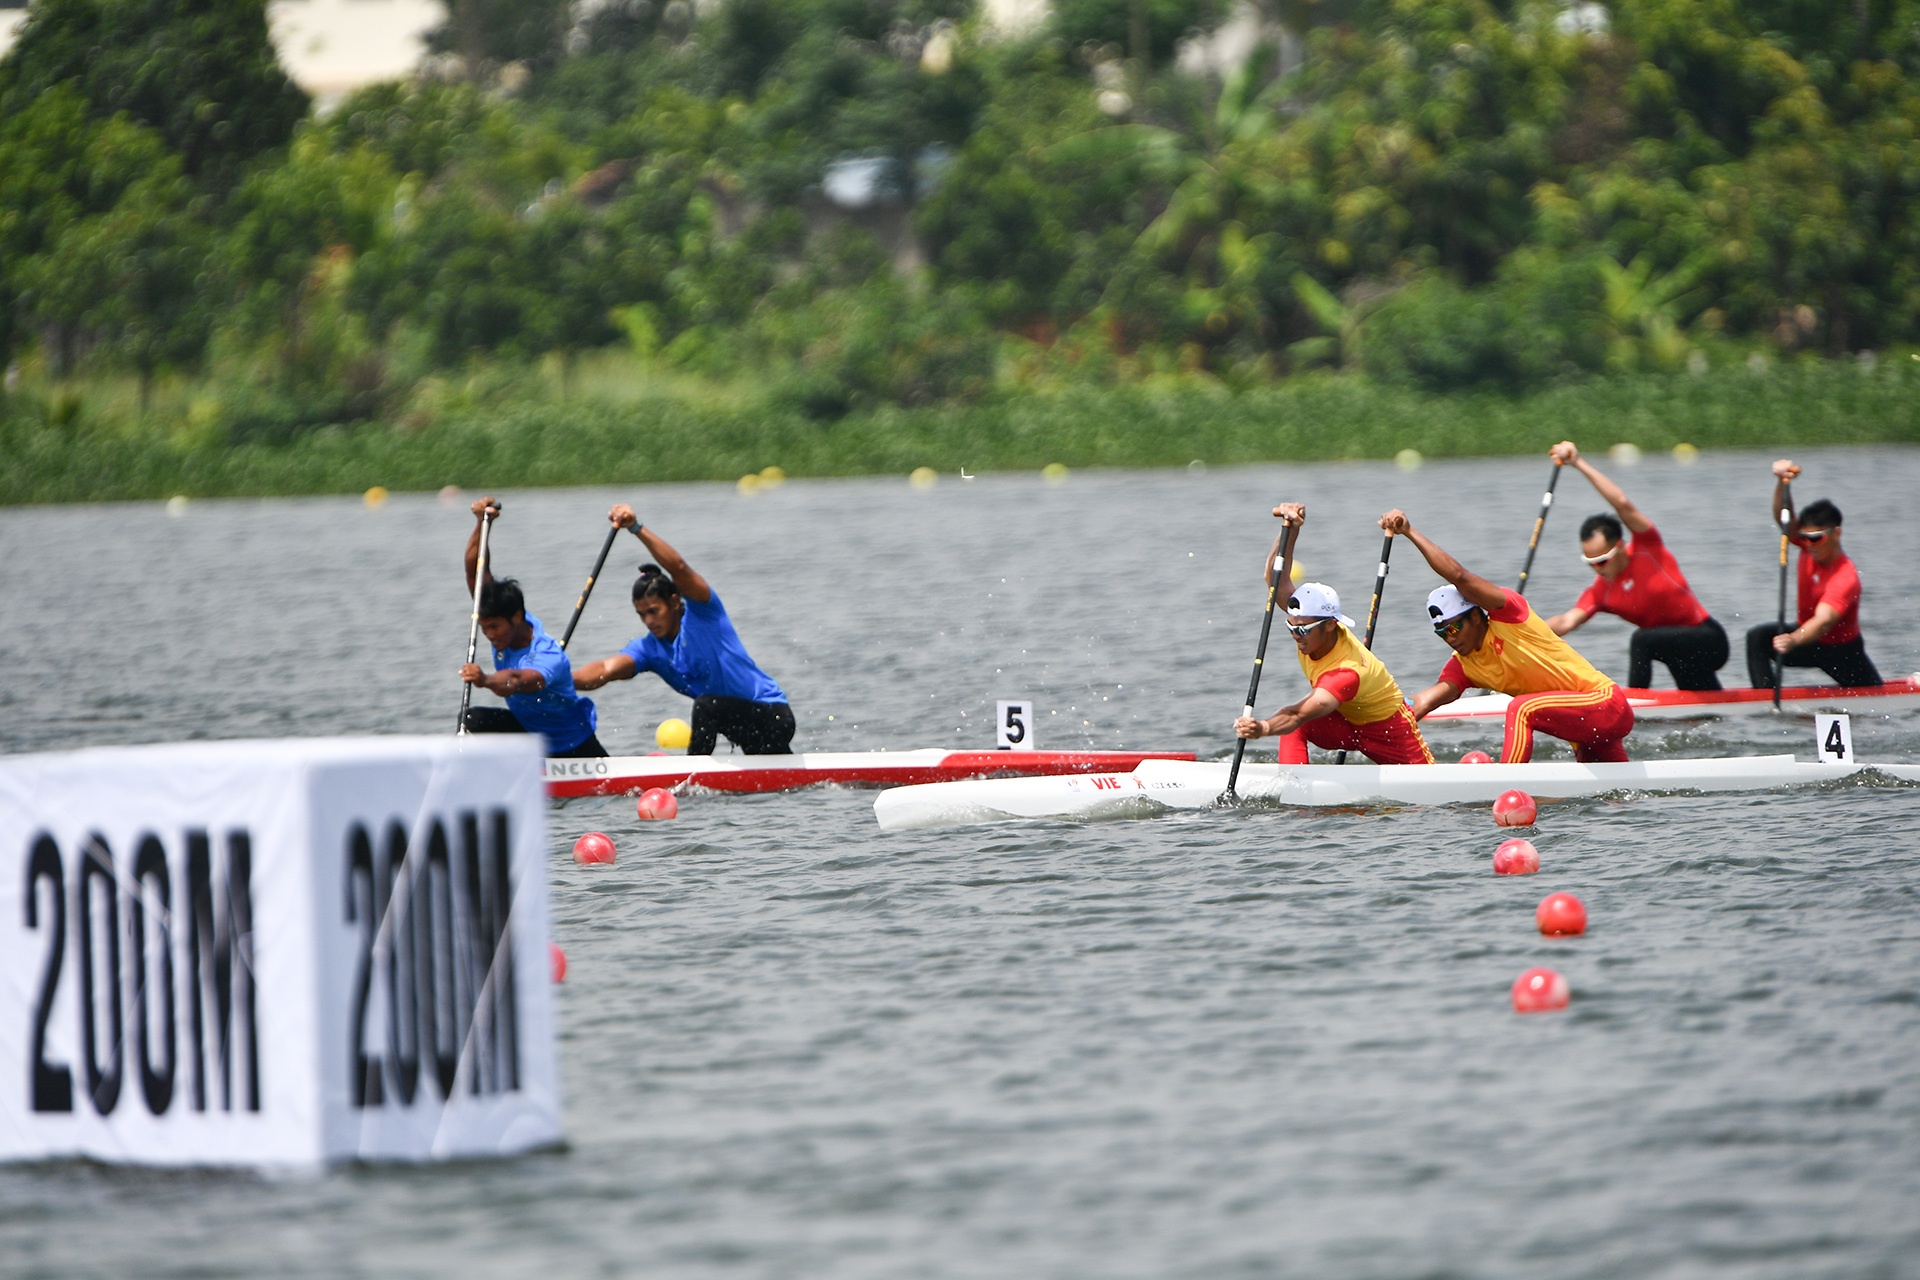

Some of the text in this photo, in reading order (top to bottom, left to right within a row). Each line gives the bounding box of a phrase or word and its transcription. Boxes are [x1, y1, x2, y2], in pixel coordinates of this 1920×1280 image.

[1006, 706, 1025, 744] 5
[1825, 720, 1846, 759] 4
[551, 763, 608, 776] NELO
[1090, 777, 1122, 790] VIE
[22, 828, 262, 1117] 200M
[342, 806, 523, 1110] 200M
